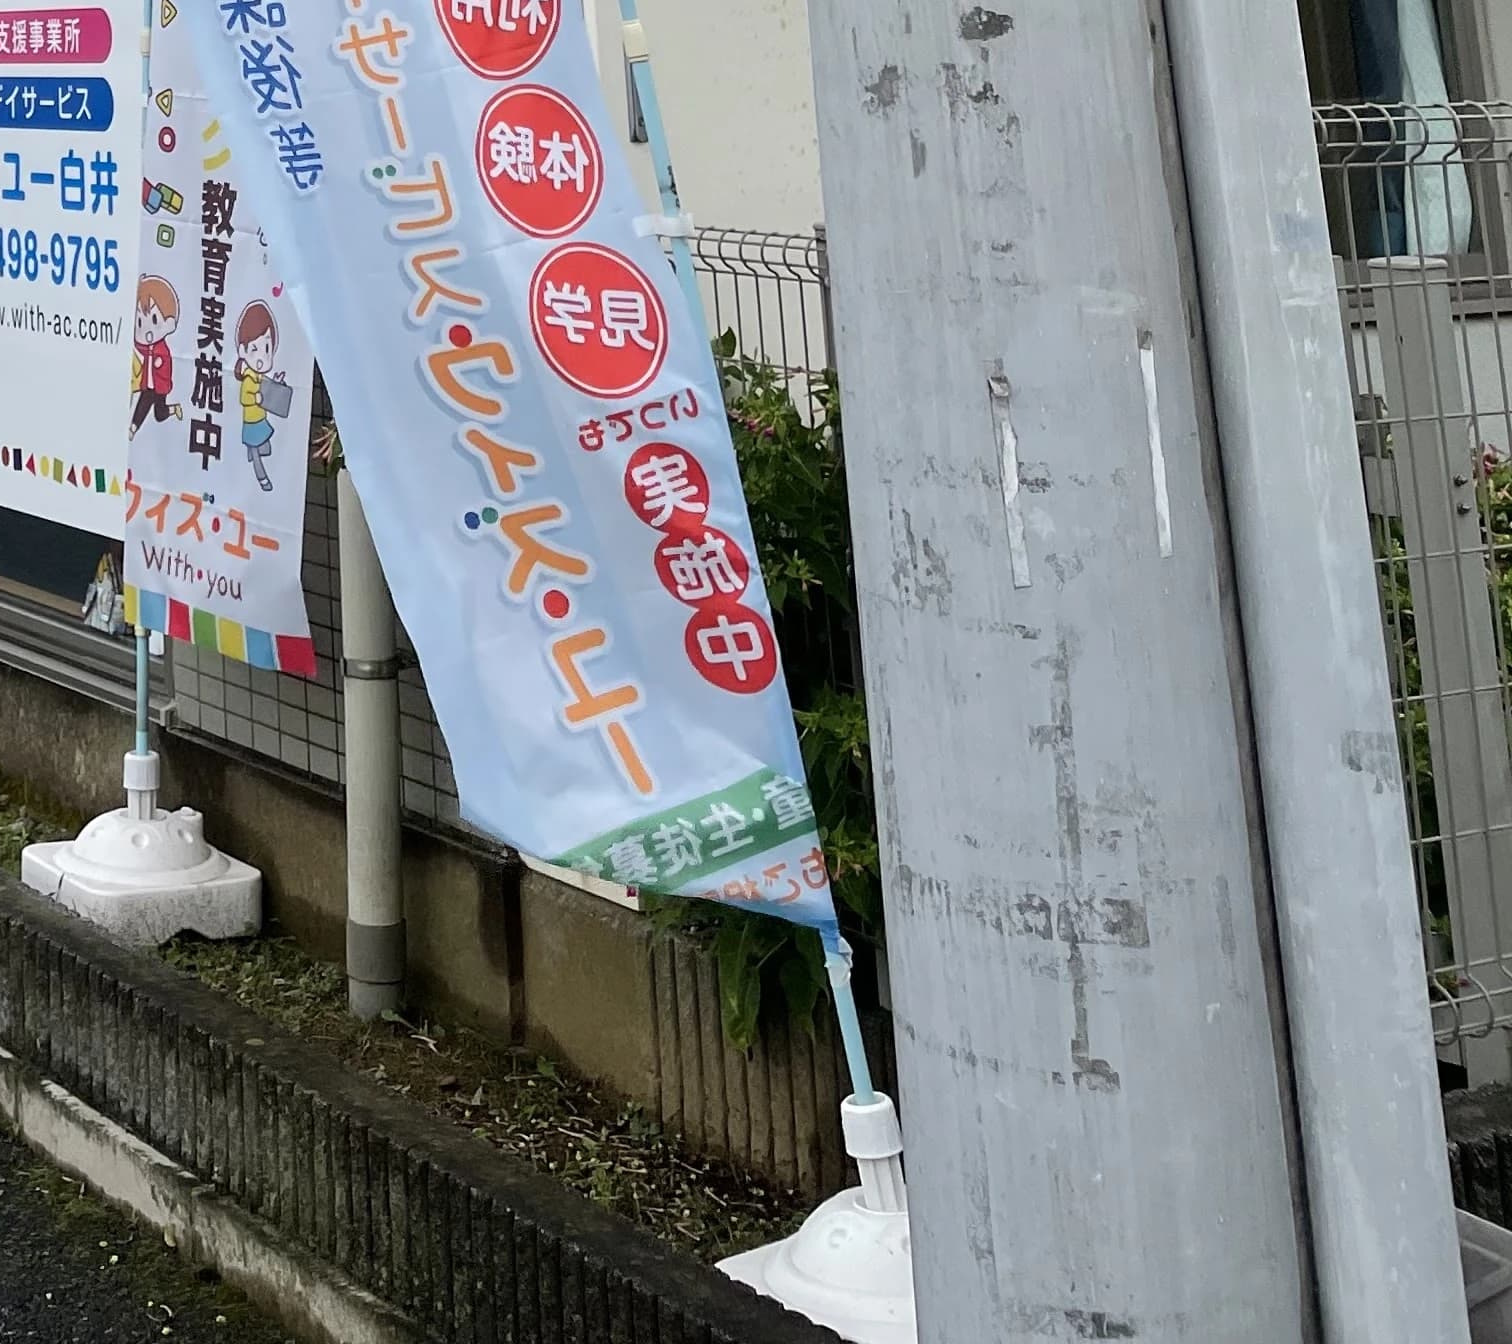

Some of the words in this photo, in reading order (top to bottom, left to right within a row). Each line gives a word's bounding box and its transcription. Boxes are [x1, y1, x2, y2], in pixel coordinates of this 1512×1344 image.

[188, 179, 238, 472] 教育実施中
